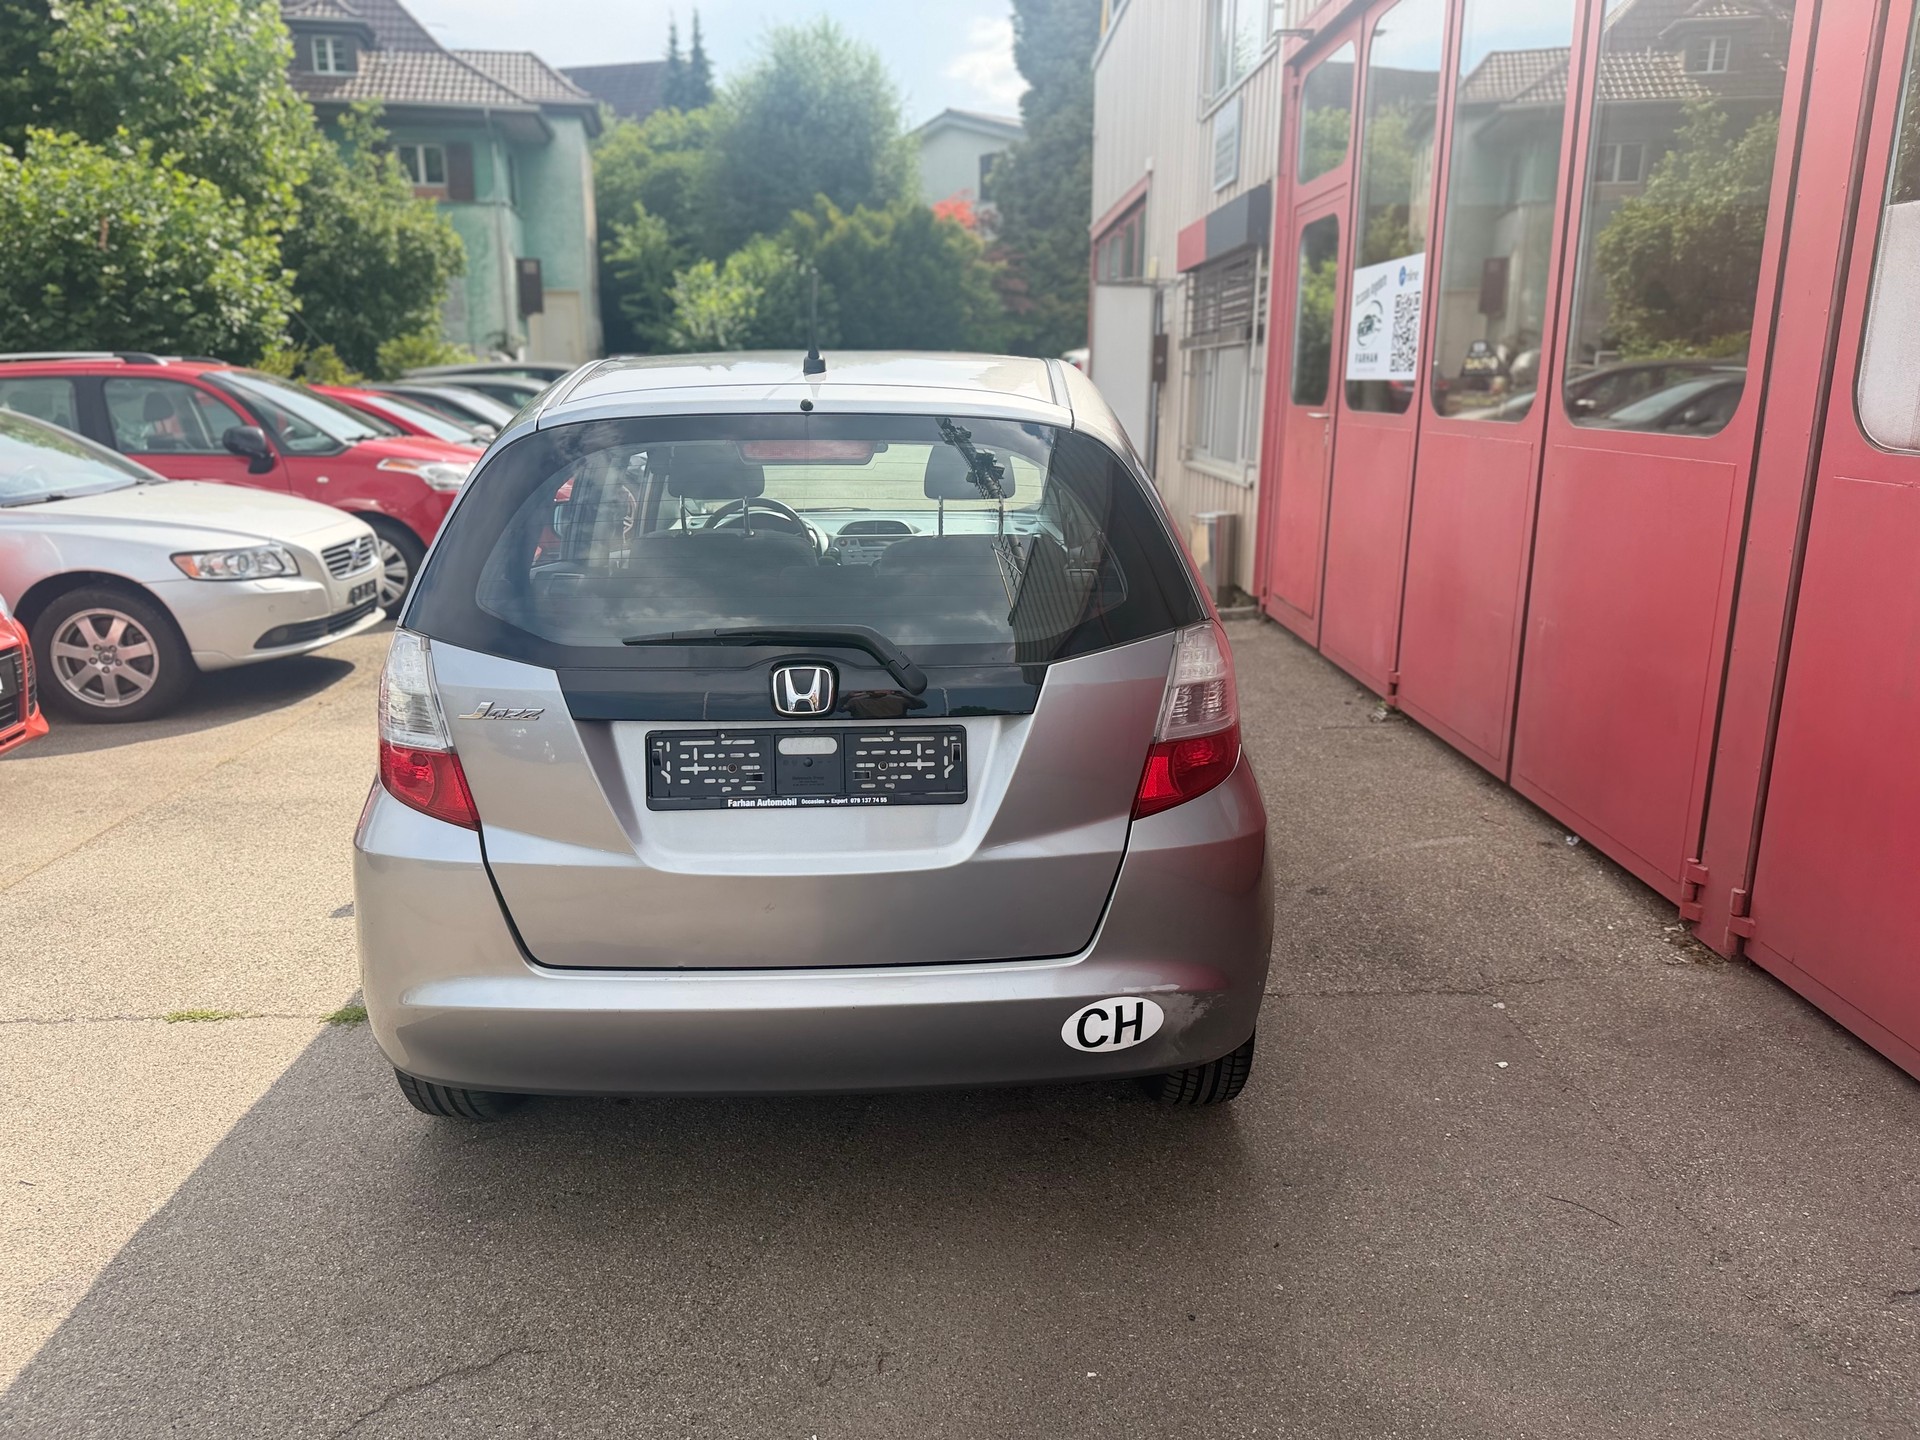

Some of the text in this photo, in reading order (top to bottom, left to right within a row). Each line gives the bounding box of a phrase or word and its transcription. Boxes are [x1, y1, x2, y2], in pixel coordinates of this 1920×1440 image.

[458, 701, 545, 720] Jazz
[727, 798, 756, 807] Farhan
[757, 797, 798, 807] Automobil
[801, 797, 825, 805] Occasion
[831, 797, 848, 805] Export
[1077, 1001, 1143, 1048] CH
